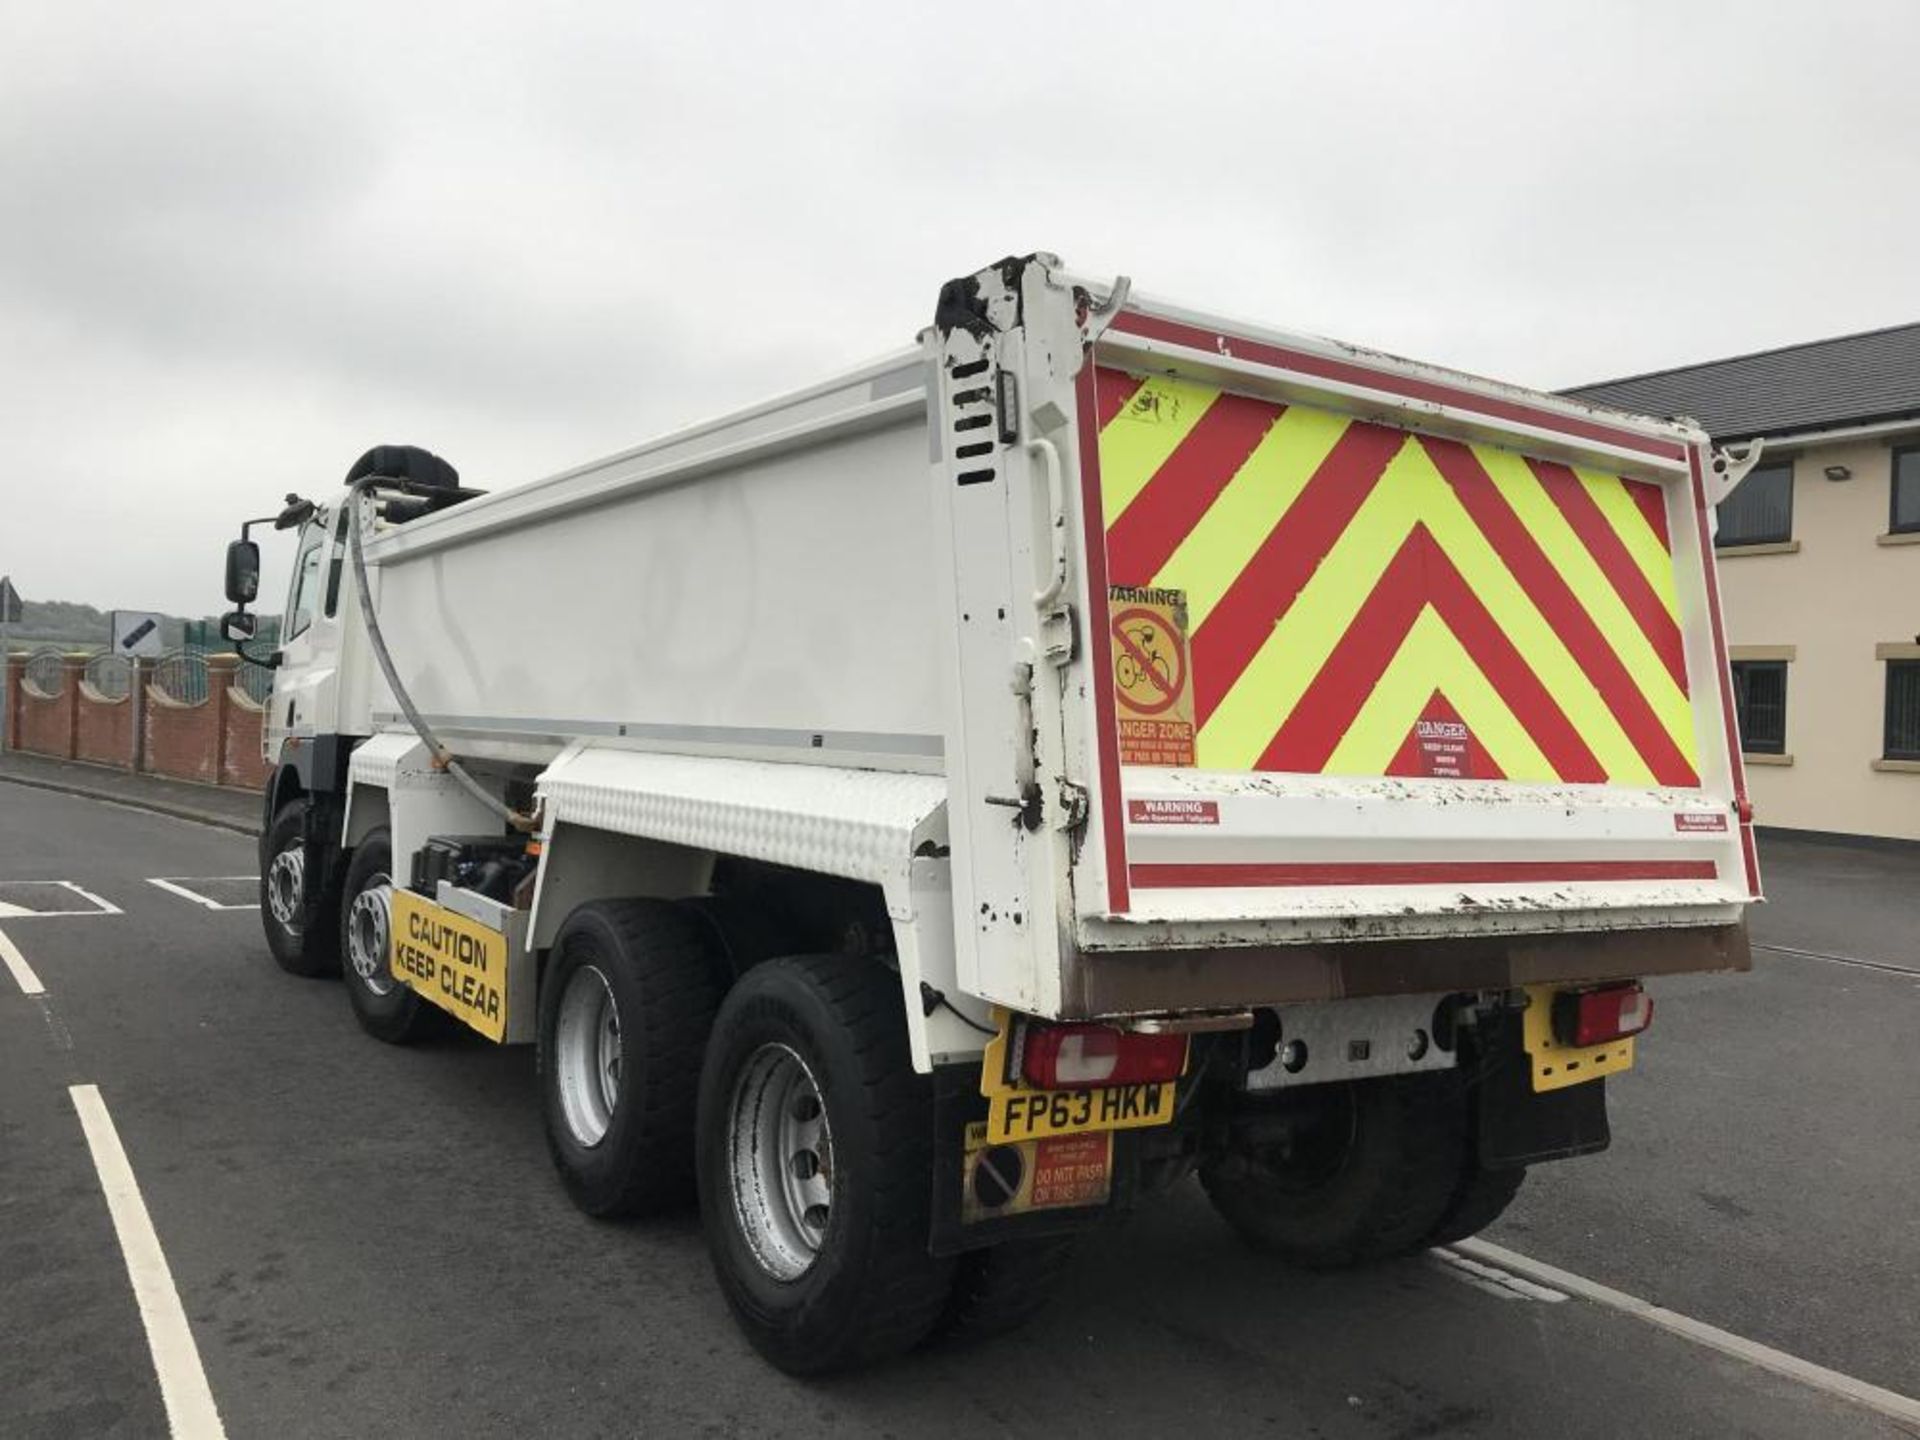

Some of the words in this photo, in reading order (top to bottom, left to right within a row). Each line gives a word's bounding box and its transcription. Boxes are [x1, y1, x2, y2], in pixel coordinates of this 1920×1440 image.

[1159, 722, 1191, 740] ZONE
[1416, 721, 1467, 737] DANGER
[1143, 800, 1203, 813] WARNING
[409, 912, 487, 972] CAUTION
[396, 940, 435, 982] KEEP
[440, 964, 499, 1022] CLEAR
[1004, 1090, 1092, 1135] FP63
[1101, 1082, 1162, 1122] HKW
